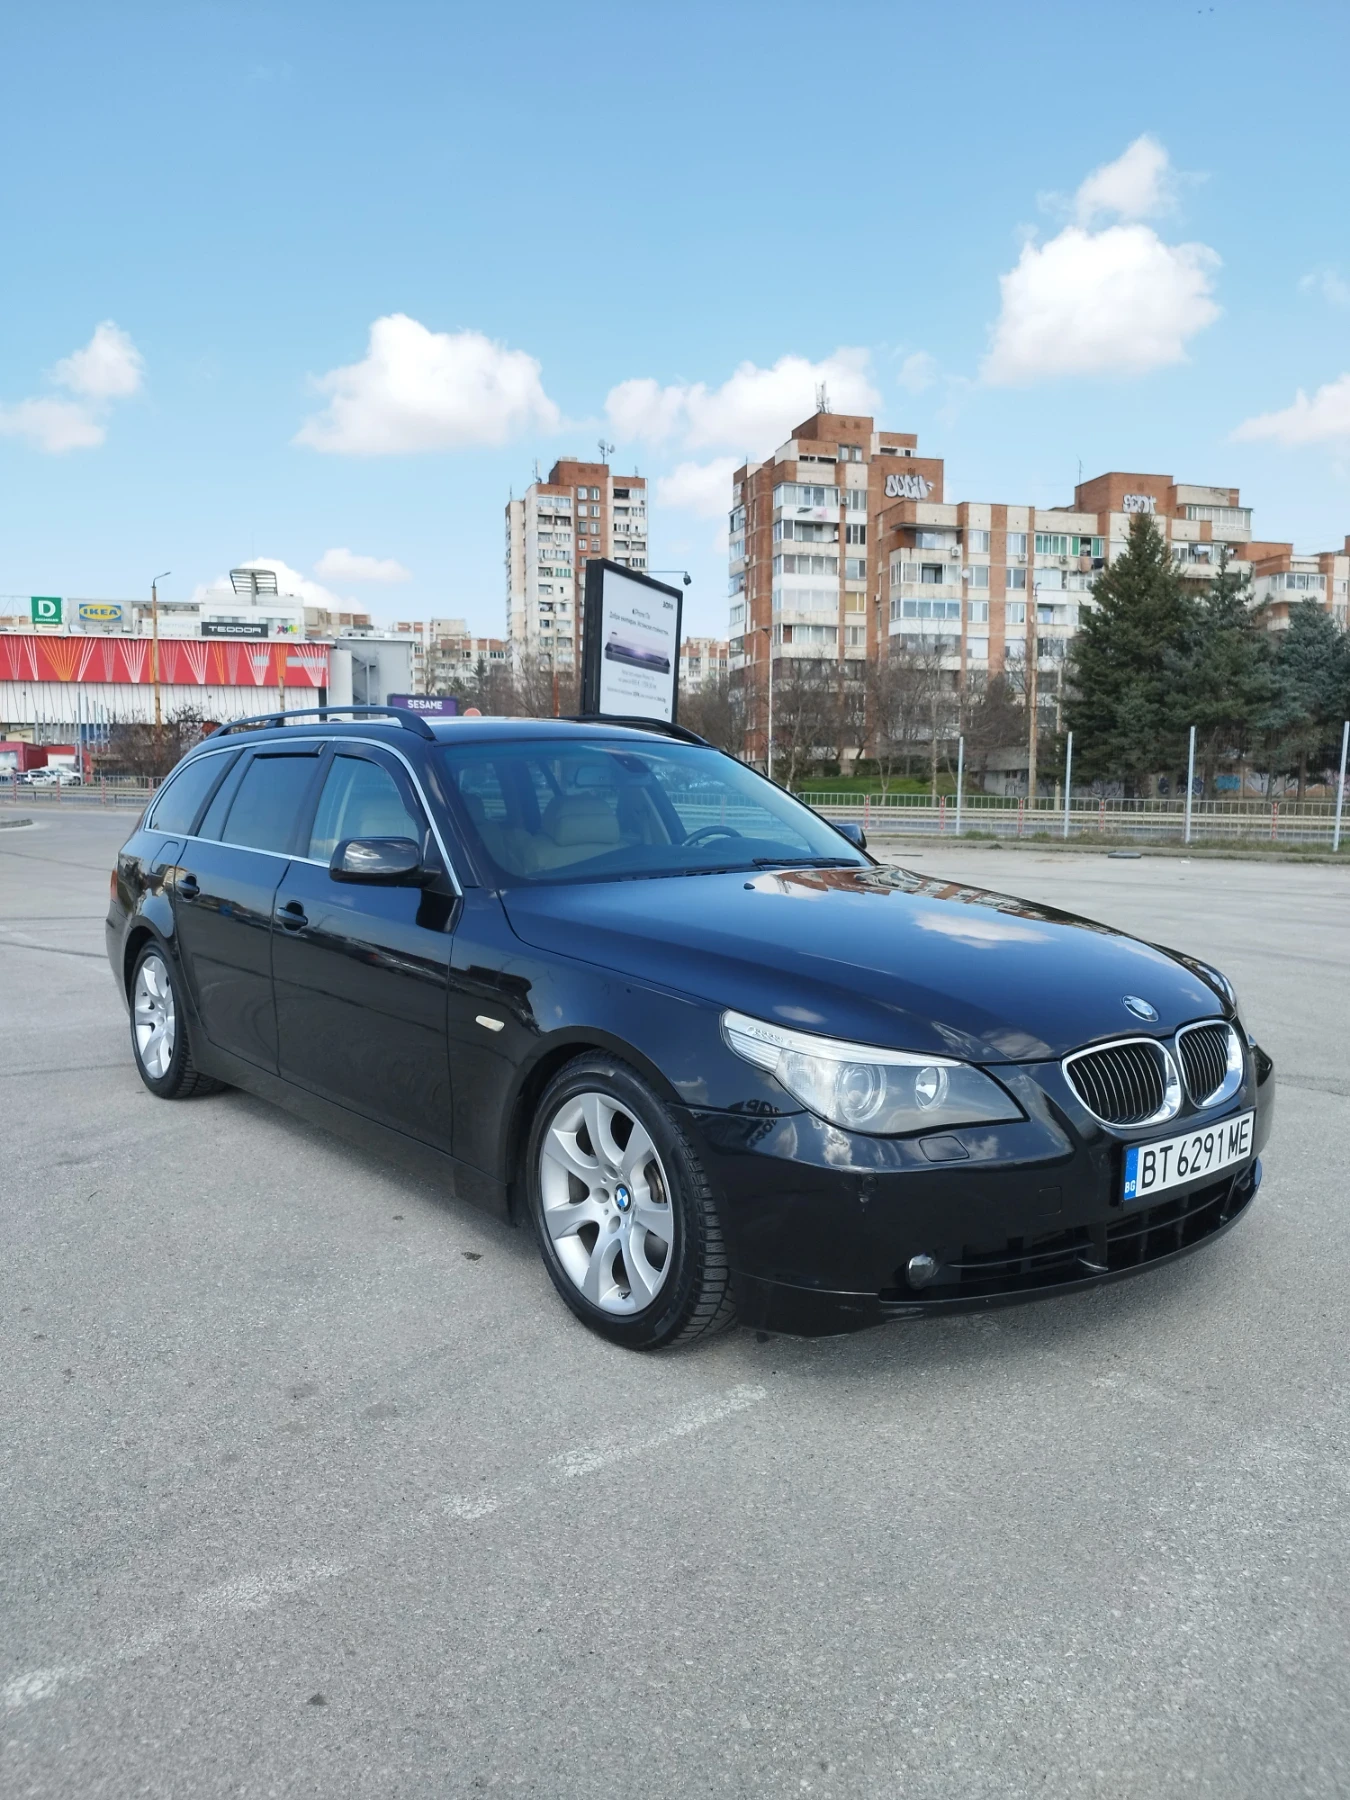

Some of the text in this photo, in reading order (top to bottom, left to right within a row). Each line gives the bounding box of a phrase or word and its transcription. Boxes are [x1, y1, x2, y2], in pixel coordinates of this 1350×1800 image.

[38, 600, 56, 617] D
[83, 608, 118, 616] IKEA
[407, 699, 443, 710] SESAME
[1141, 1118, 1250, 1190] BT 6291 ME
[1124, 1179, 1136, 1194] BG
